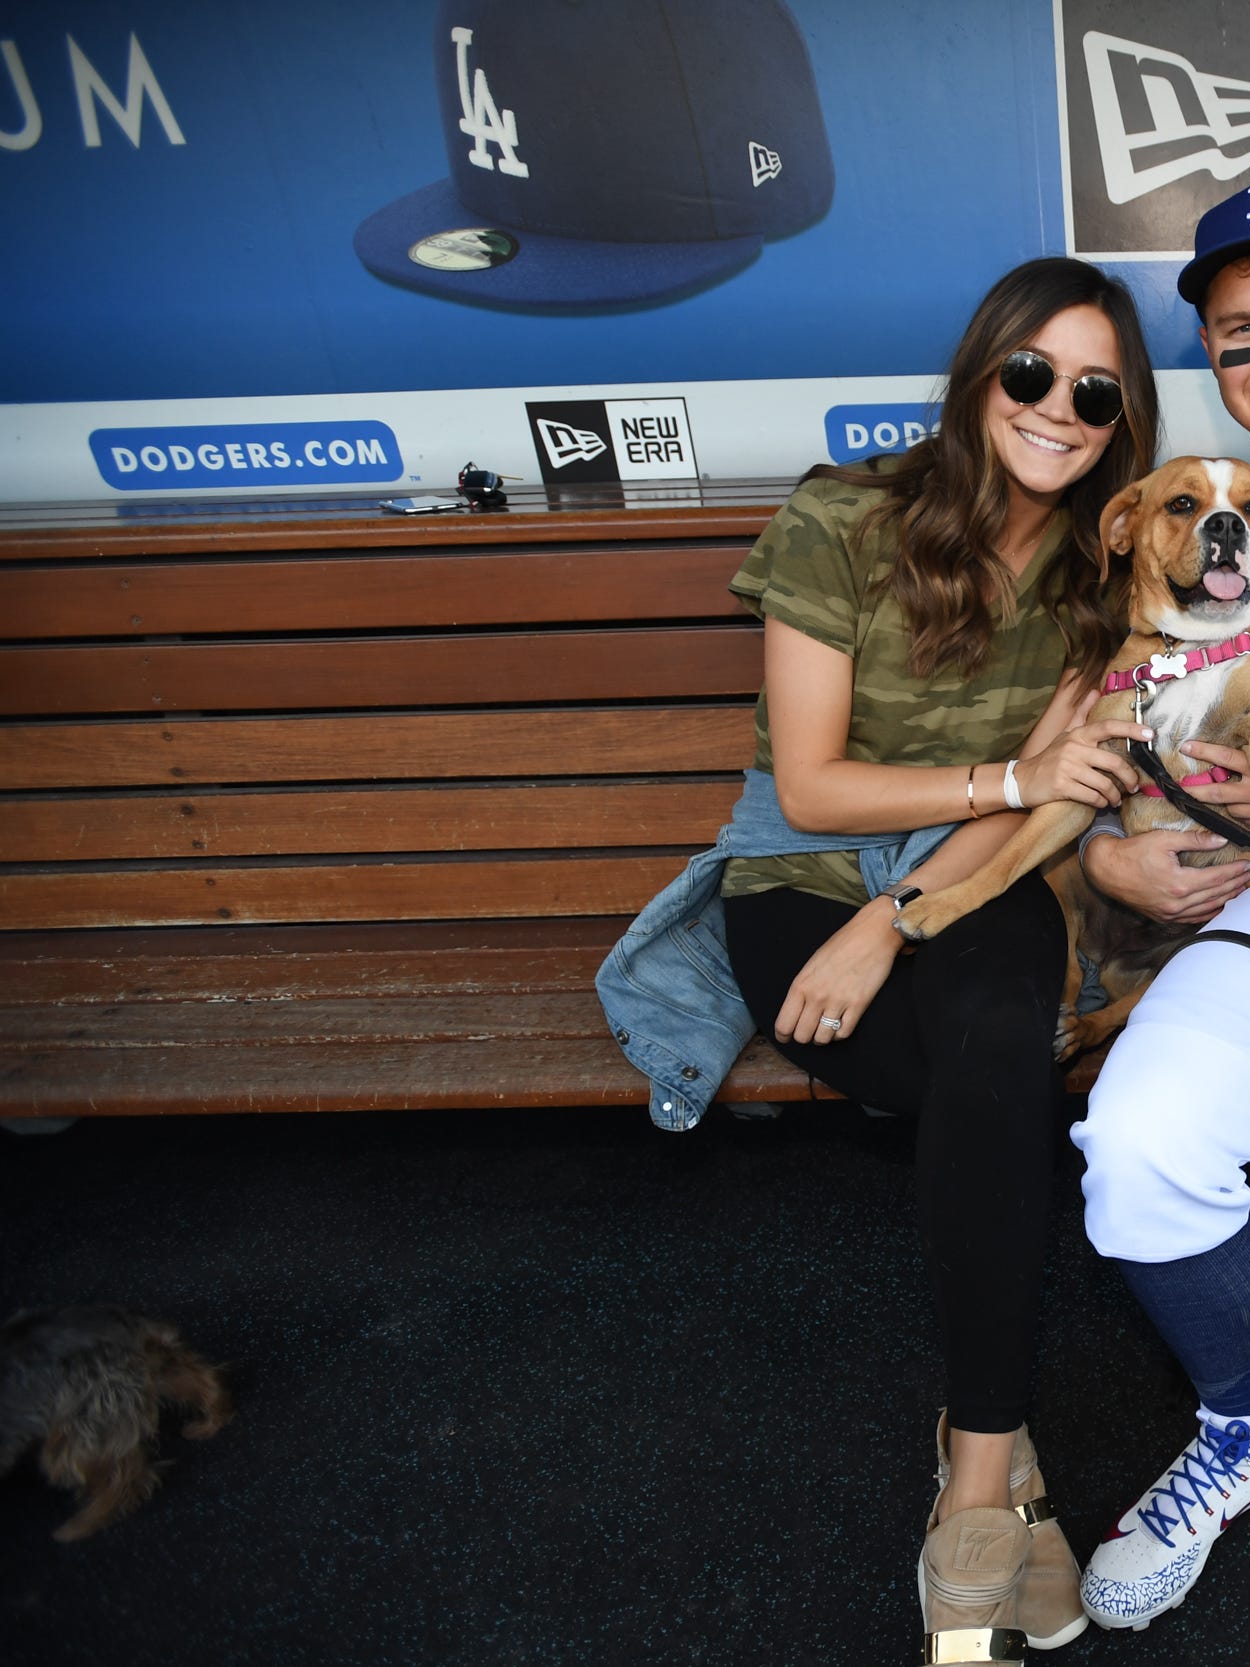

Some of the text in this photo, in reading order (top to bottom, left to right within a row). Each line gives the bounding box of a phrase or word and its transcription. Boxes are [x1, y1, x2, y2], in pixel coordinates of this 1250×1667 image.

[450, 26, 530, 179] LA
[621, 416, 679, 440] NEW
[112, 438, 388, 472] DODGERS.COM
[626, 440, 684, 463] ERA
